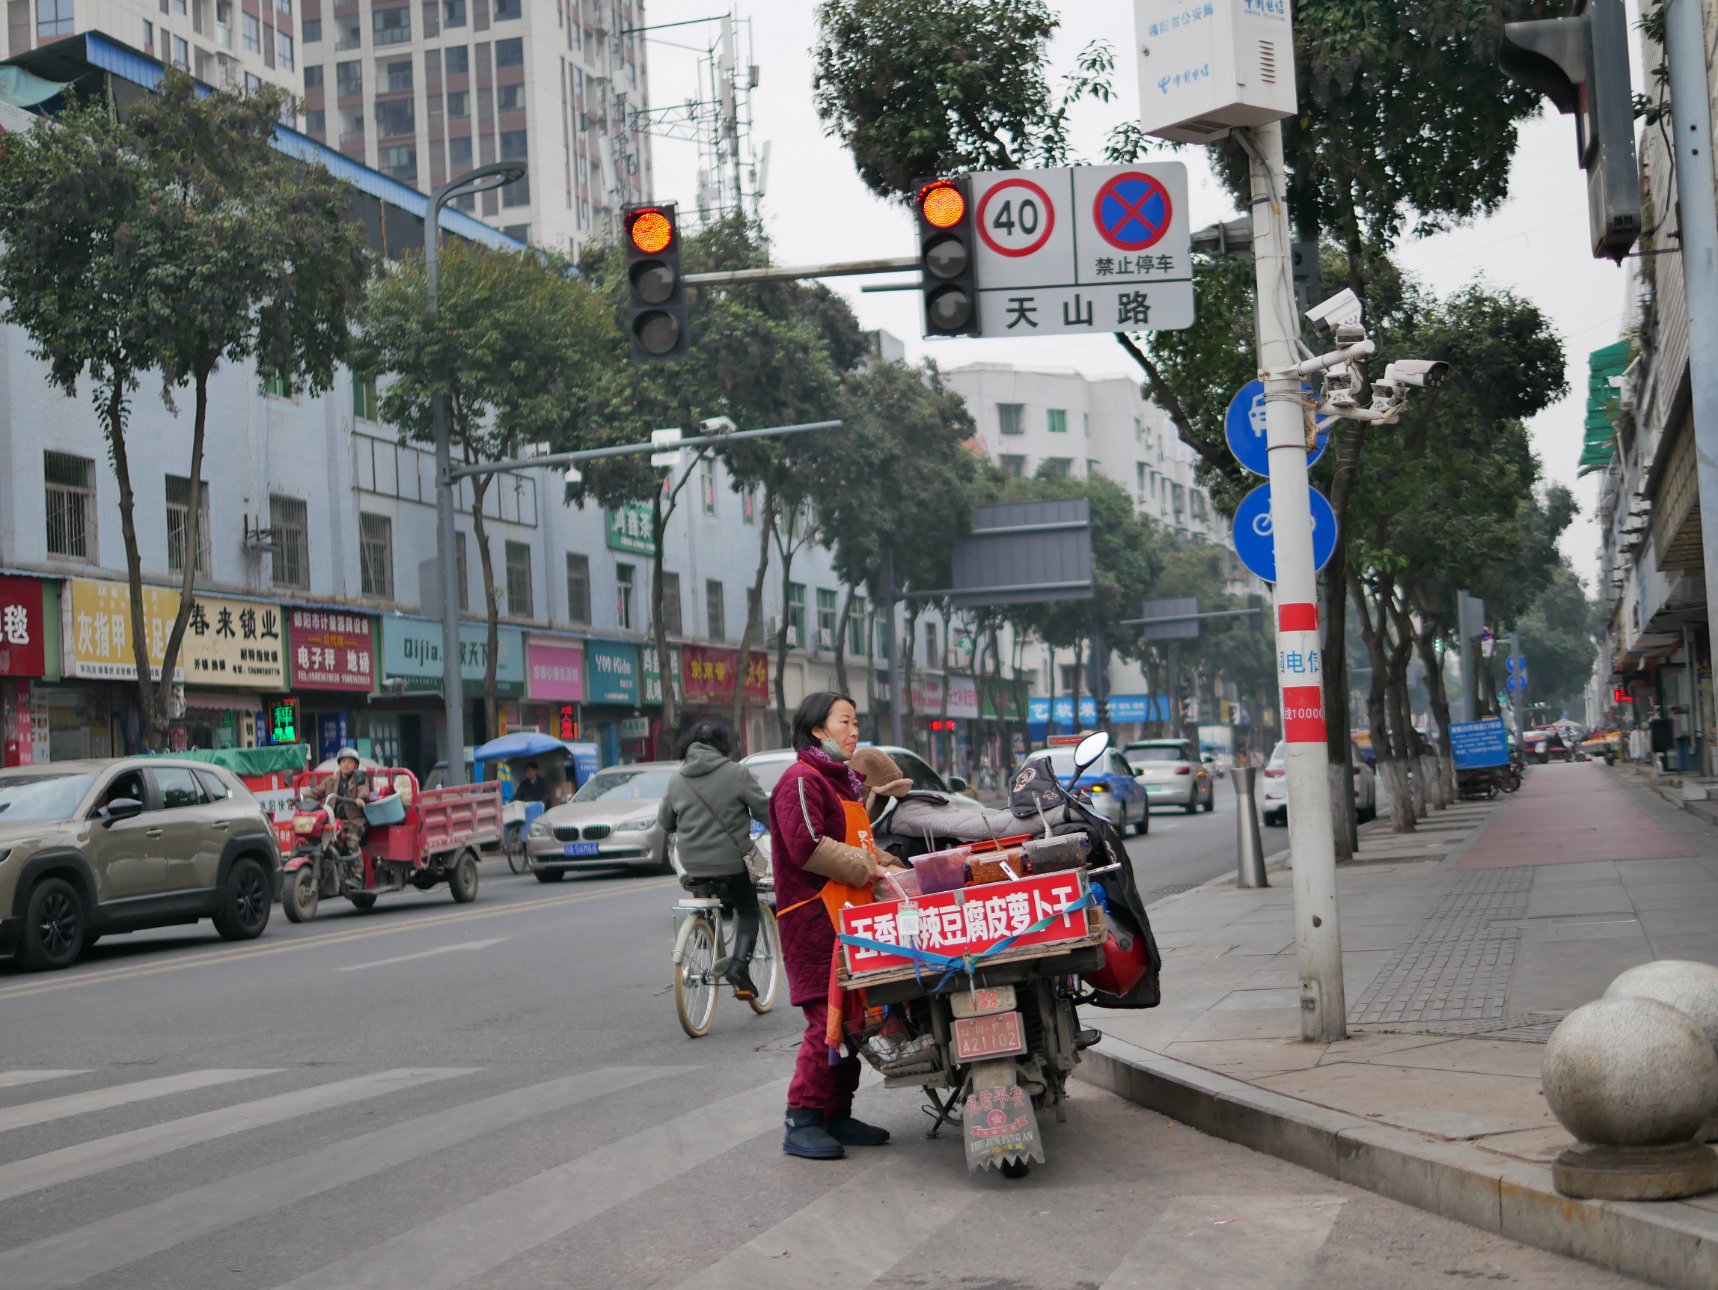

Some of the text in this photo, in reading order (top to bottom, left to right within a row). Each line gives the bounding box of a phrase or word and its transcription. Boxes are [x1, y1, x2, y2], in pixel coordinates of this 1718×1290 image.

[993, 198, 1038, 236] 40
[1095, 254, 1175, 276] 禁止停车
[1006, 291, 1151, 329] 天山路
[0, 604, 30, 646] 毯
[189, 602, 279, 640] 春来锁业
[297, 645, 336, 671] 电子秤
